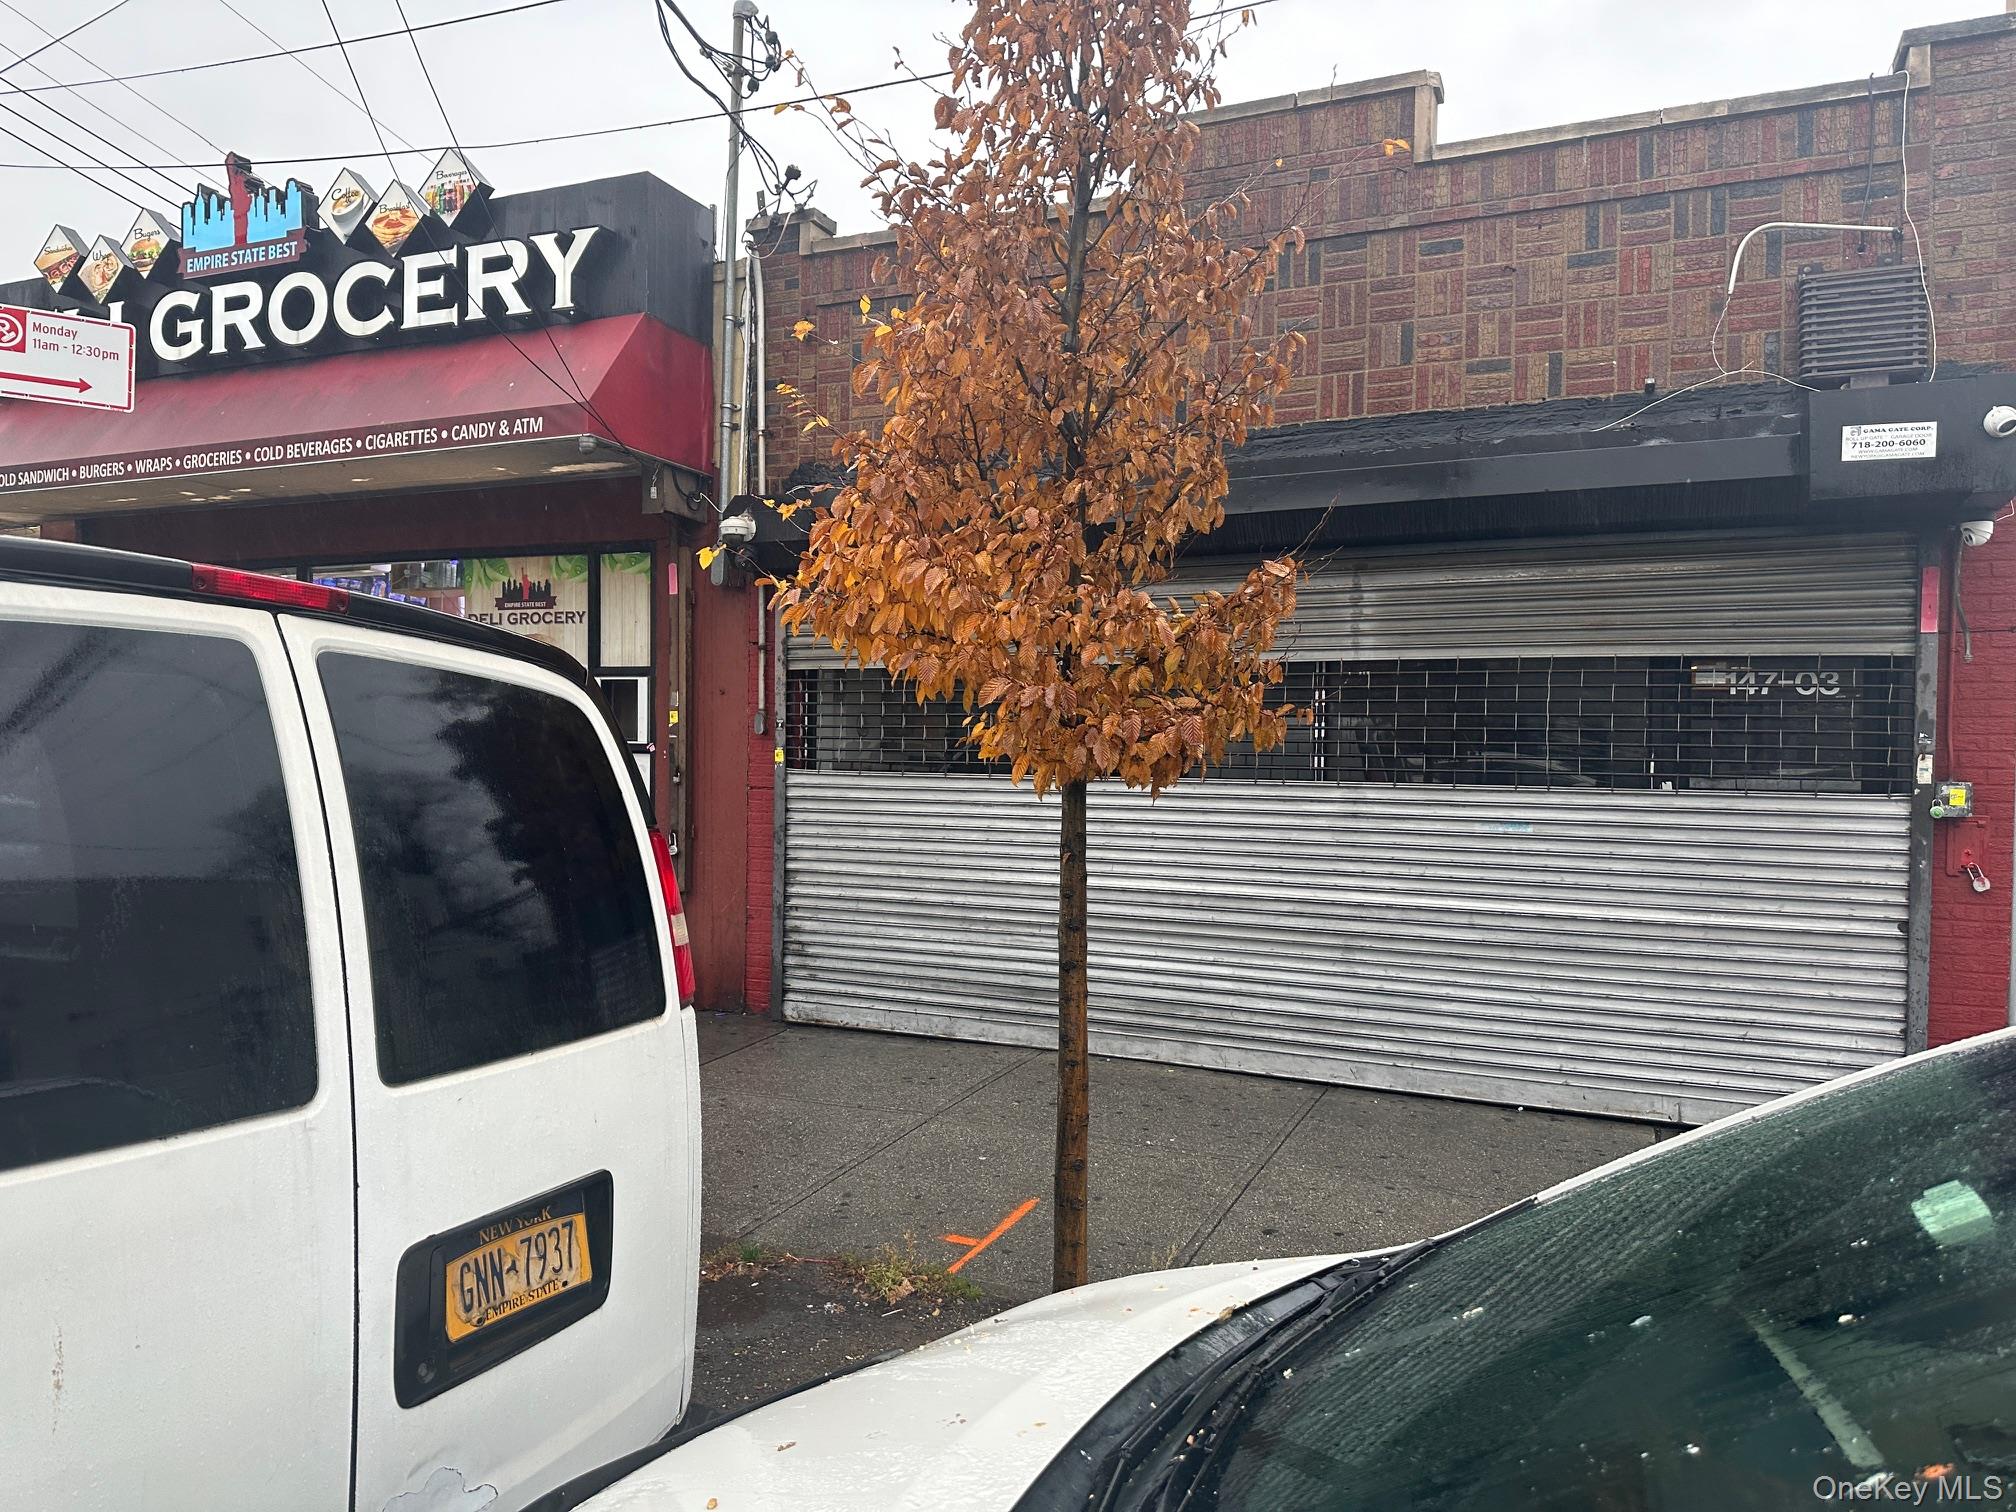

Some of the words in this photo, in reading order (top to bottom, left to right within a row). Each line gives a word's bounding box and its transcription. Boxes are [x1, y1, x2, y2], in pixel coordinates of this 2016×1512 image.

[331, 187, 360, 204] Coffee
[187, 252, 229, 273] EMPIRE
[230, 246, 266, 266] STATE
[268, 240, 298, 260] BEST
[150, 226, 600, 362] GROCERY
[32, 322, 78, 340] Monday
[32, 338, 60, 352] 11am
[18, 467, 70, 486] SANDWICH
[79, 461, 125, 480] BURGERS
[135, 456, 173, 474] WRAPS
[182, 449, 242, 470] GROCERIES
[253, 444, 283, 463] COLD
[286, 437, 353, 460] BEVERAGES
[365, 427, 438, 451] CIGARETTES
[451, 421, 496, 442] CANDY
[498, 419, 510, 436] &
[512, 416, 544, 435] ATM
[1851, 438, 1926, 449] 718-200-6060
[468, 613, 502, 626] DELI
[507, 611, 586, 625] GROCERY
[1727, 671, 1841, 695] 147-03
[479, 1219, 513, 1245] NEW
[459, 1247, 506, 1314] GNN
[520, 1219, 574, 1287] 7937
[486, 1294, 525, 1321] EMPIRE
[527, 1278, 560, 1302] STATE
